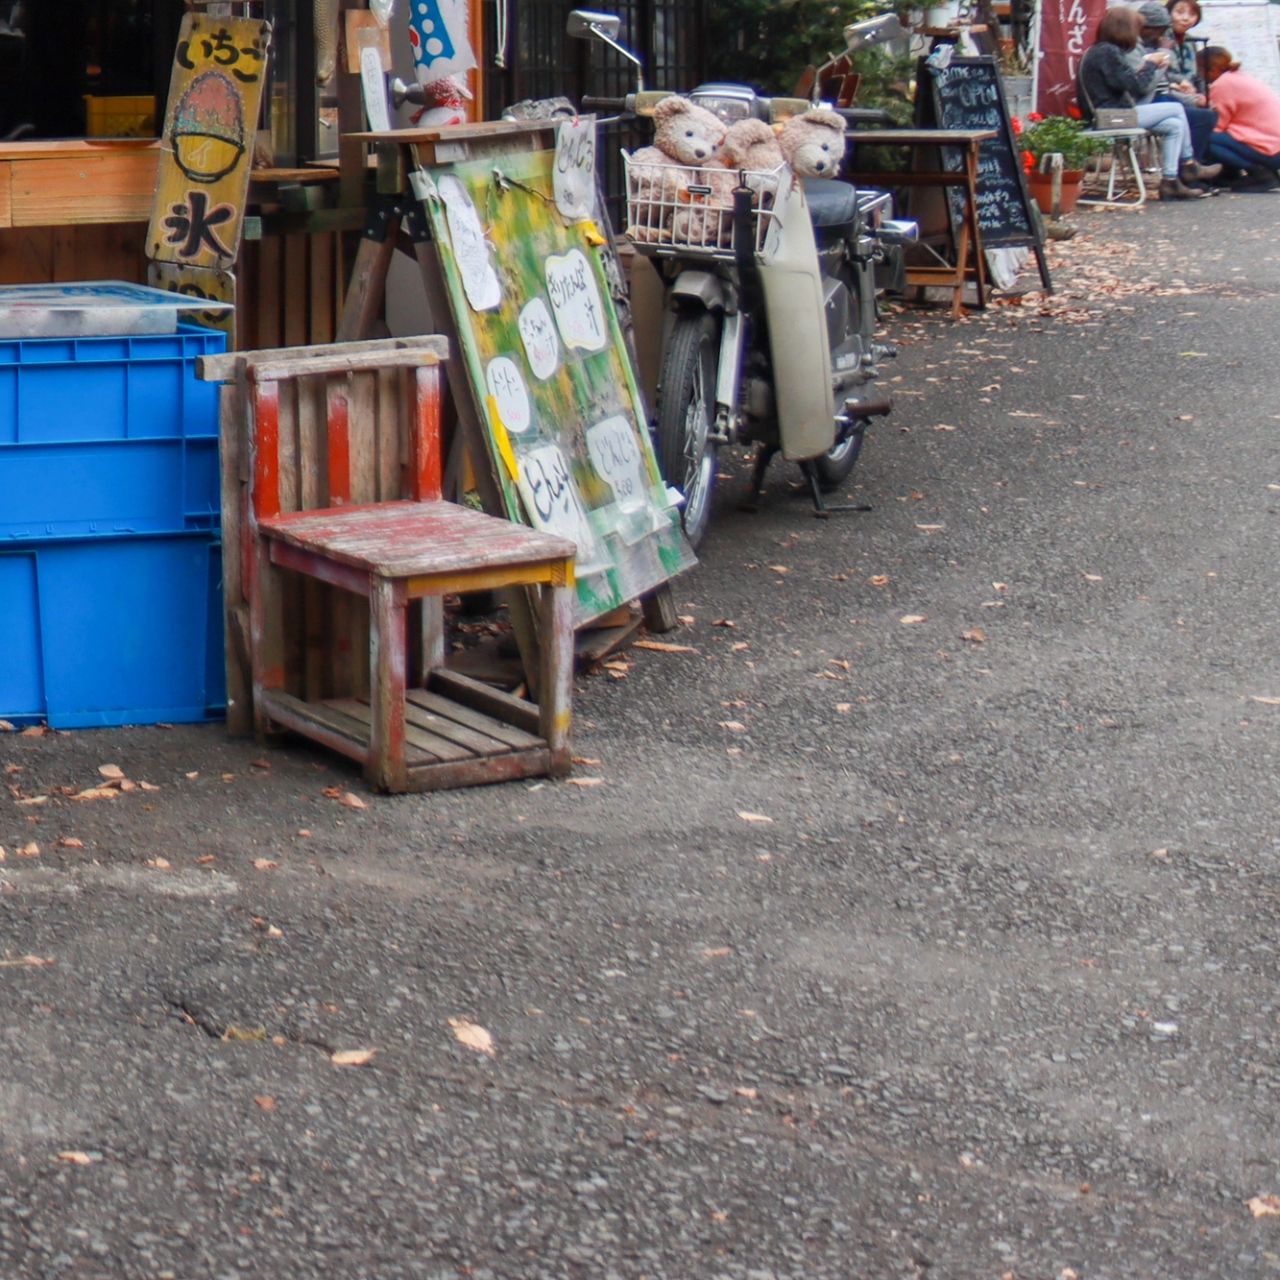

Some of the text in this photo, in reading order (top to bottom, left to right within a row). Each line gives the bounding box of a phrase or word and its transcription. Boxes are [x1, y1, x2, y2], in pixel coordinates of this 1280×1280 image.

[176, 28, 268, 83] いちご
[160, 190, 237, 259] 氷
